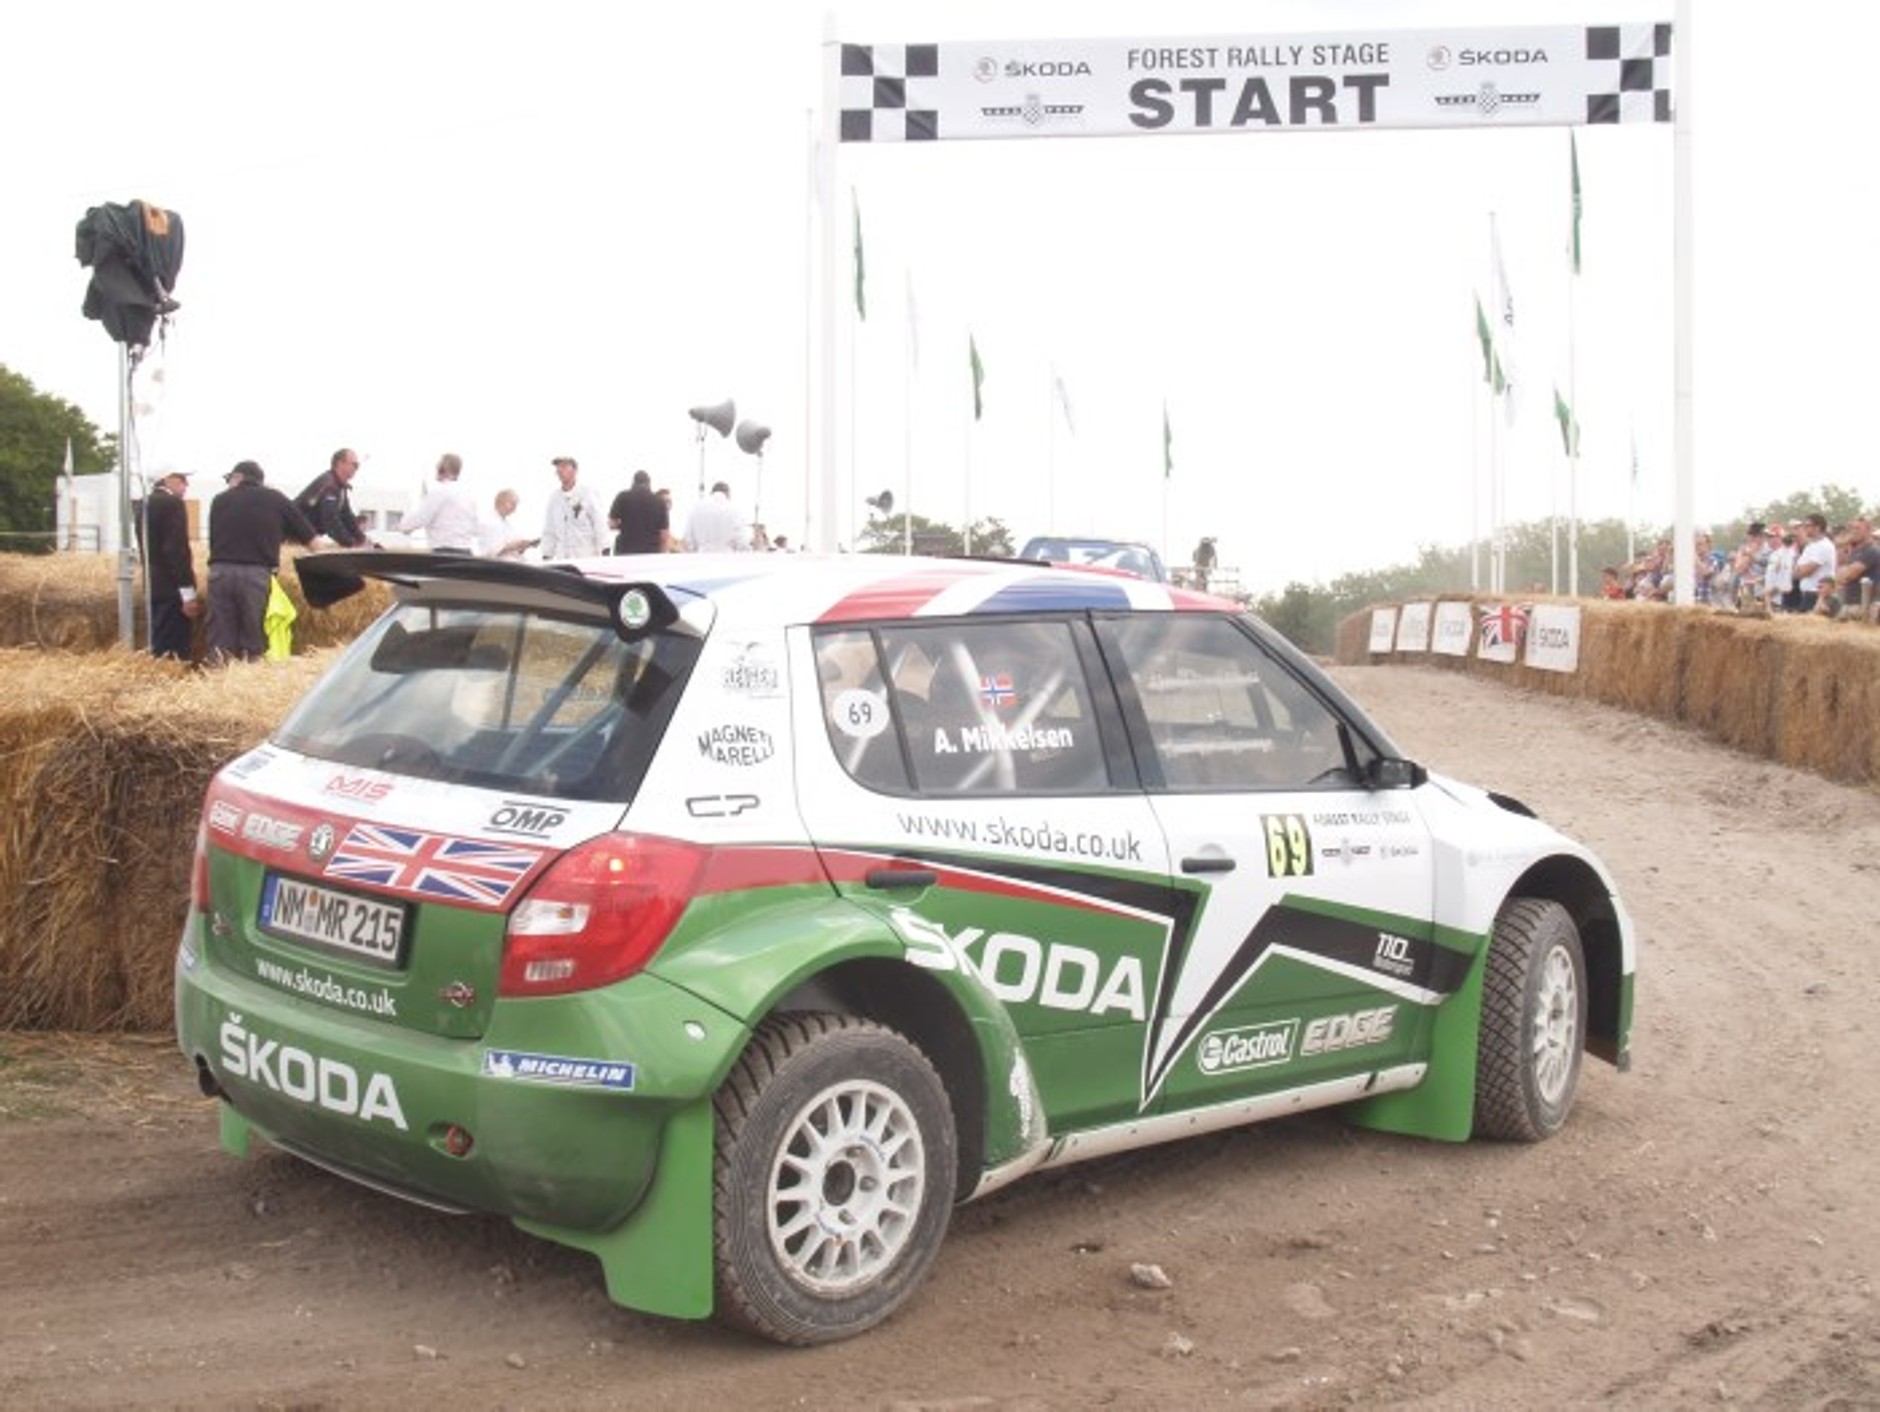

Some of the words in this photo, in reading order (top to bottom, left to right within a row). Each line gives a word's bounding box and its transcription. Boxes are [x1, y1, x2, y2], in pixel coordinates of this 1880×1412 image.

[1127, 47, 1219, 70] FOREST
[1226, 45, 1304, 68] RALLY
[1312, 43, 1390, 66] STAGE
[1128, 73, 1390, 129] START
[848, 702, 871, 725] 69
[933, 727, 957, 754] A.
[489, 806, 566, 833] OMP
[897, 813, 1143, 862] www.skoda.co.uk
[1266, 814, 1308, 877] 69
[314, 893, 349, 941] MR
[349, 903, 400, 953] 215
[255, 957, 397, 1017] www.skoda.co.uk
[1221, 1026, 1291, 1066] Castrol
[1300, 1004, 1399, 1056] EDGE
[220, 1012, 409, 1131] ŠKODA
[518, 1058, 628, 1081] MICHELIN
